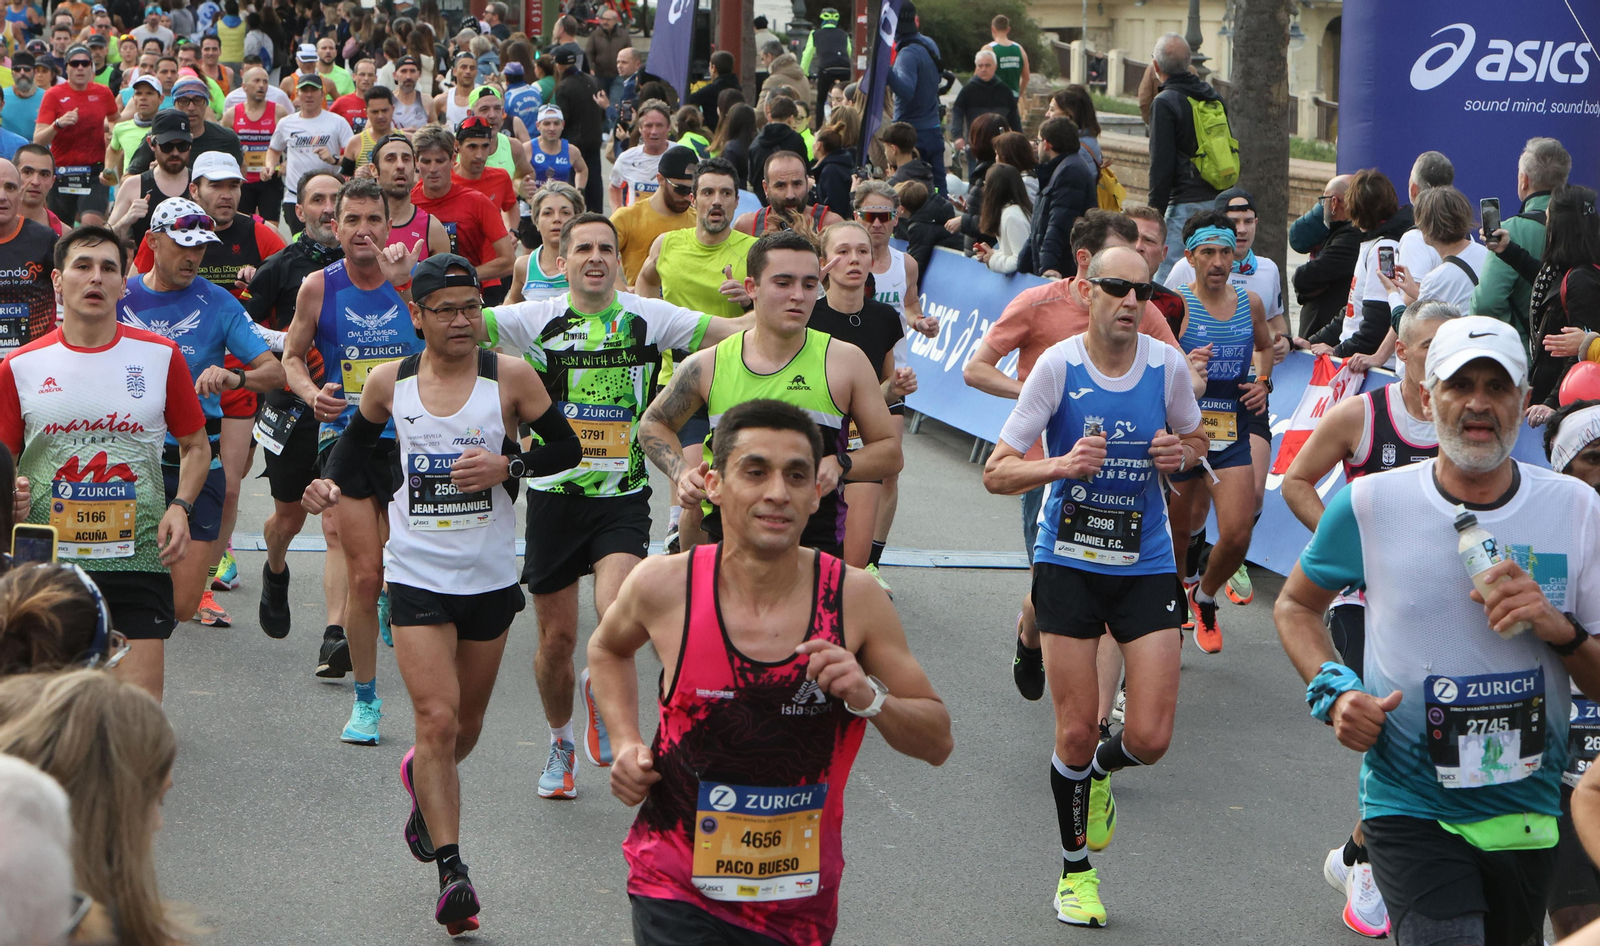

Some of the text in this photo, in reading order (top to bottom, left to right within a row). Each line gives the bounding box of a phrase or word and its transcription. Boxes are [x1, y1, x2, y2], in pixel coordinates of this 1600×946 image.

[1475, 39, 1592, 84] asics
[1464, 98, 1511, 112] sound
[1512, 98, 1547, 114] mind,
[1550, 100, 1585, 114] sound
[209, 265, 222, 273] La
[347, 329, 398, 338] OWL RUNNERS
[357, 336, 390, 344] ALICANTE
[363, 346, 402, 356] ZURICH
[561, 356, 579, 366] RUN
[582, 355, 608, 366] WITH
[1201, 401, 1232, 409] ZURICH
[582, 407, 624, 418] ZURICH
[43, 411, 145, 435] maratón
[73, 436, 116, 446] JEREZ
[580, 429, 605, 440] 3791
[77, 486, 126, 497] ZURICH
[1090, 492, 1135, 506] ZURICH
[411, 500, 491, 514] JEAN-EMMANUEL
[77, 511, 106, 523] 5166
[1087, 515, 1115, 531] 2998
[75, 529, 108, 541] ACUÑA
[1073, 532, 1124, 549] DANIEL F.C.
[791, 681, 809, 702] team
[1466, 677, 1534, 698] ZURICH
[781, 702, 833, 716] islasport
[1466, 717, 1509, 736] 2745
[744, 792, 813, 810] ZURICH
[740, 829, 782, 849] 4656
[715, 857, 799, 876] PACO BUESO
